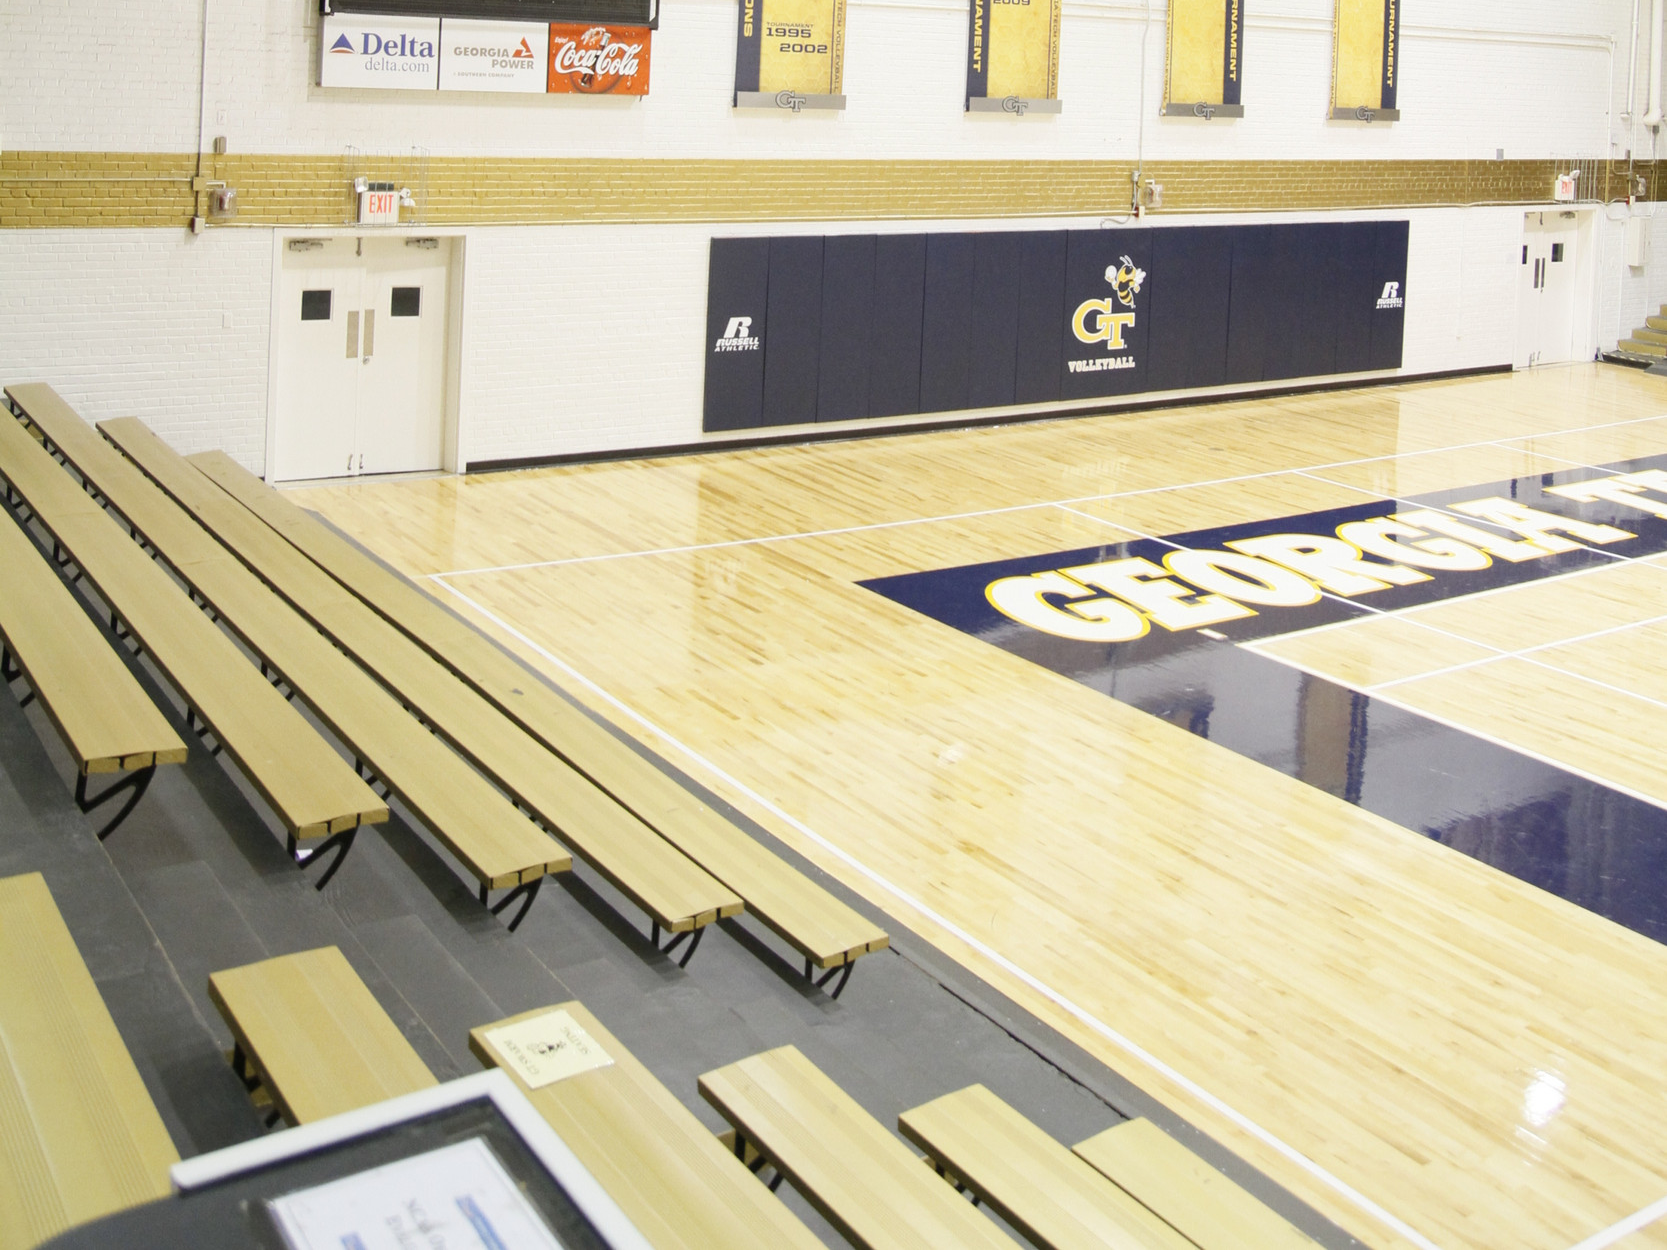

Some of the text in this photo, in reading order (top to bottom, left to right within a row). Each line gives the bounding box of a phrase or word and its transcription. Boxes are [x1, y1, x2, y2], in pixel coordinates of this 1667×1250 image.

[836, 0, 844, 27] TECH
[766, 21, 814, 29] TOURNAMENT
[766, 27, 812, 38] 1995
[360, 32, 435, 58] Delta
[453, 46, 510, 58] GEORGIA
[779, 43, 828, 54] 2002
[364, 57, 430, 73] delta.com
[491, 59, 534, 70] POWER
[368, 193, 394, 214] EXIT
[723, 316, 753, 338] R
[1072, 297, 1136, 350] GT
[714, 344, 760, 352] ATHLETIC
[715, 337, 760, 347] RUSSELL
[1068, 356, 1136, 373] VOLLEYBALL
[985, 496, 1639, 642] GEORGIA
